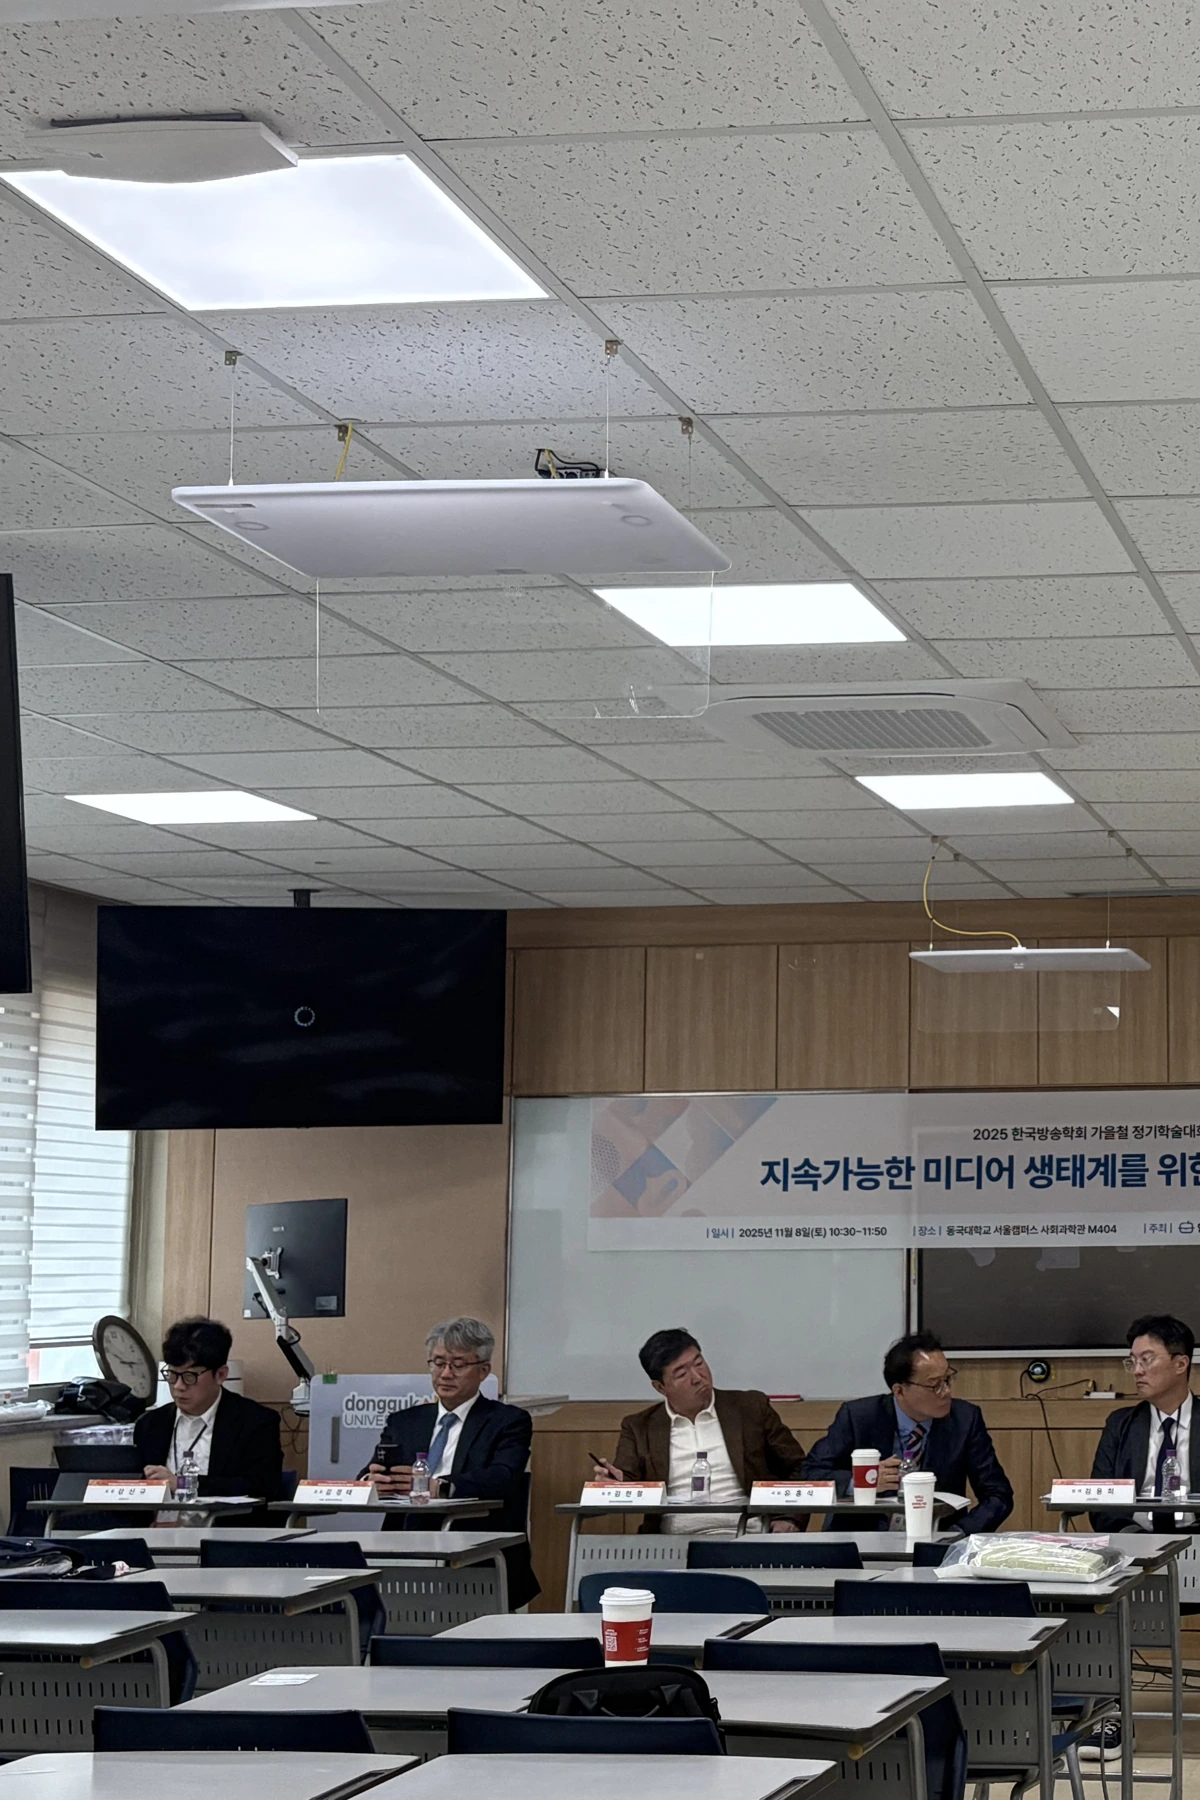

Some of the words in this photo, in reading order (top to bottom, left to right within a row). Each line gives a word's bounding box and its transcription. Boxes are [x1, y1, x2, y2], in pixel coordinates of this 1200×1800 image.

[973, 1128, 1008, 1141] 2025
[1012, 1126, 1087, 1141] 한국방송학회
[1090, 1125, 1129, 1140] 가을철
[760, 1155, 915, 1192] 지속가능한
[924, 1154, 1014, 1190] 미디어
[1024, 1153, 1149, 1188] 생태계를
[739, 1227, 773, 1238] 2025년
[775, 1227, 793, 1238] 11월
[795, 1227, 827, 1239] 8일(토)
[946, 1225, 991, 1236] 동국대학교
[993, 1224, 1038, 1236] 서울캠퍼스
[1040, 1224, 1085, 1235] 사회과학관
[1088, 1224, 1117, 1234] M404
[345, 1414, 387, 1426] UNIVE
